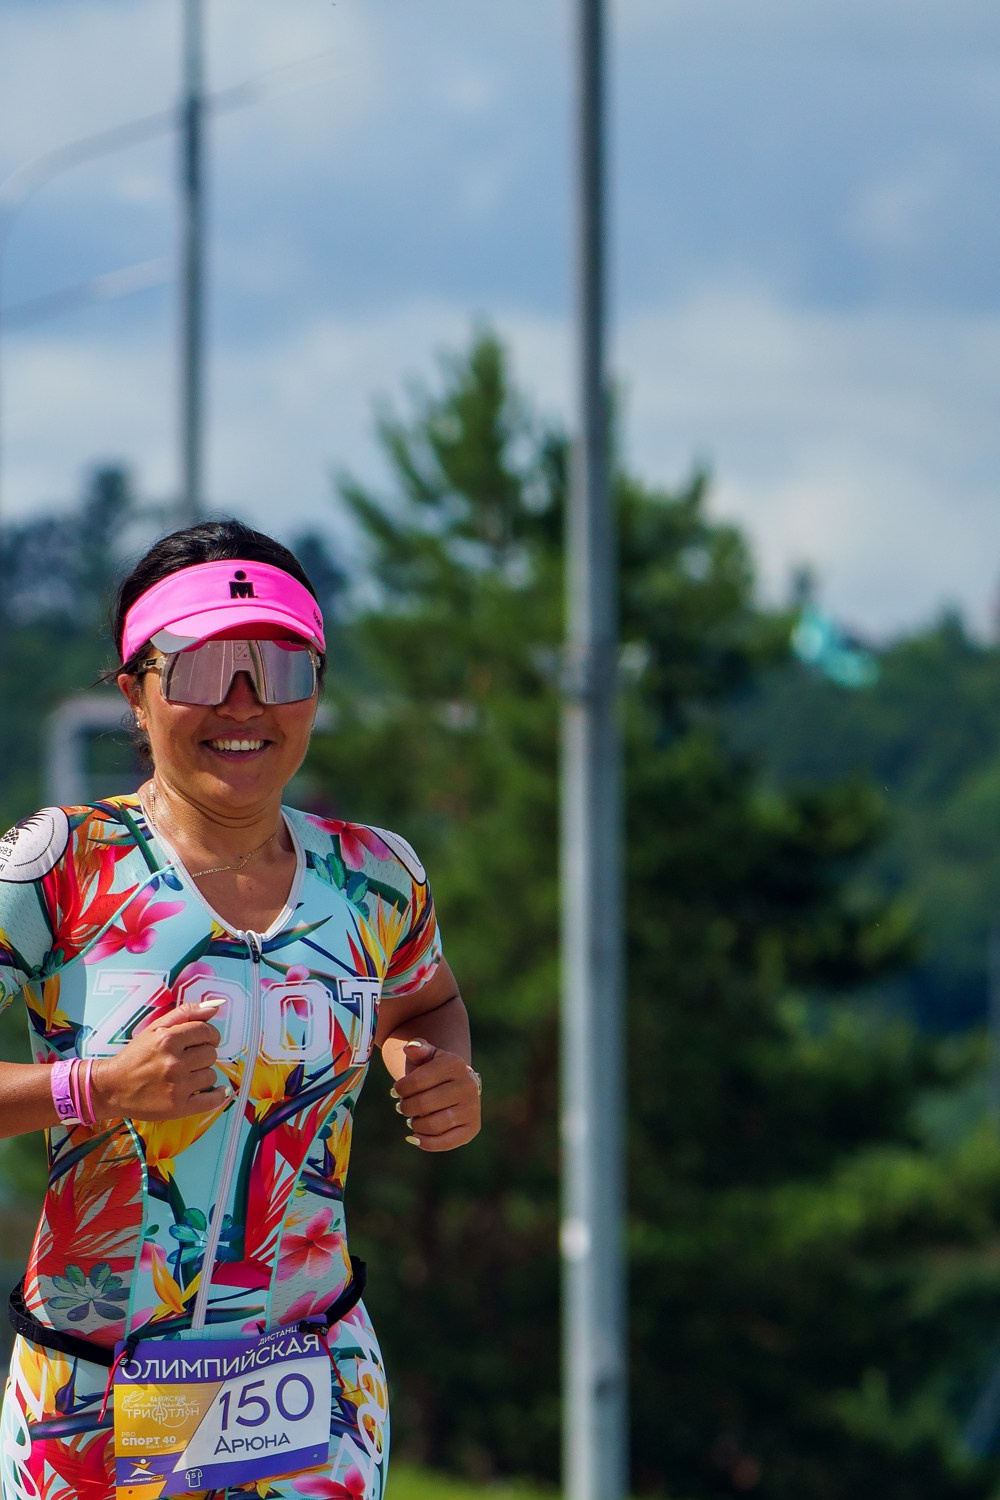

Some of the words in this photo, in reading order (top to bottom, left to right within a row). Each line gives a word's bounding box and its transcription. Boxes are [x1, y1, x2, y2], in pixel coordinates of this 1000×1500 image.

[82, 969, 384, 1067] ZOOT
[56, 1094, 80, 1119] 15
[258, 1324, 300, 1346] ДИСТАНЦ
[121, 1333, 320, 1380] ОЛИМПИЙСКАЯ
[218, 1372, 315, 1431] 150
[121, 1437, 160, 1446] СПОРТ
[162, 1436, 177, 1444] 40
